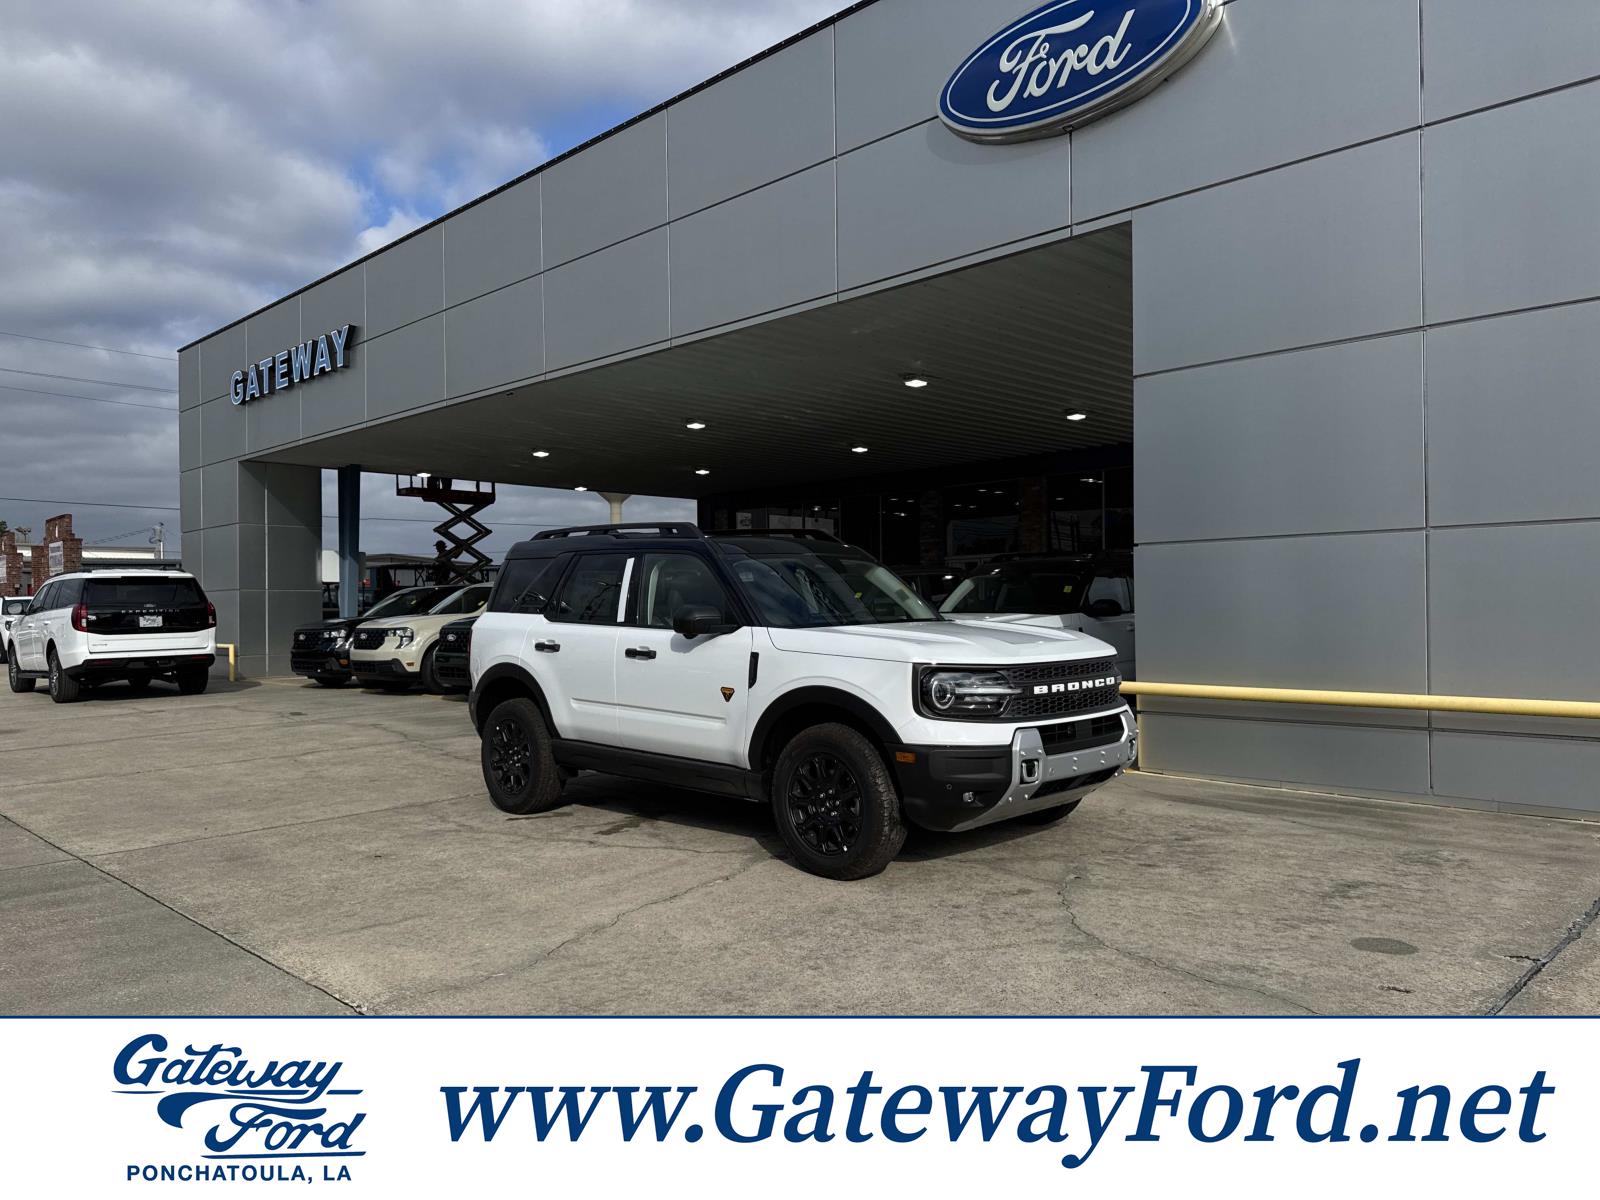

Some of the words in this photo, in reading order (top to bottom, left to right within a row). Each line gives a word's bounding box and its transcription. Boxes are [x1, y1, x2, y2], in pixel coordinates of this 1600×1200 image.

[986, 8, 1136, 113] Ford
[230, 324, 353, 405] GATEWAY
[1033, 676, 1117, 695] BRONCO
